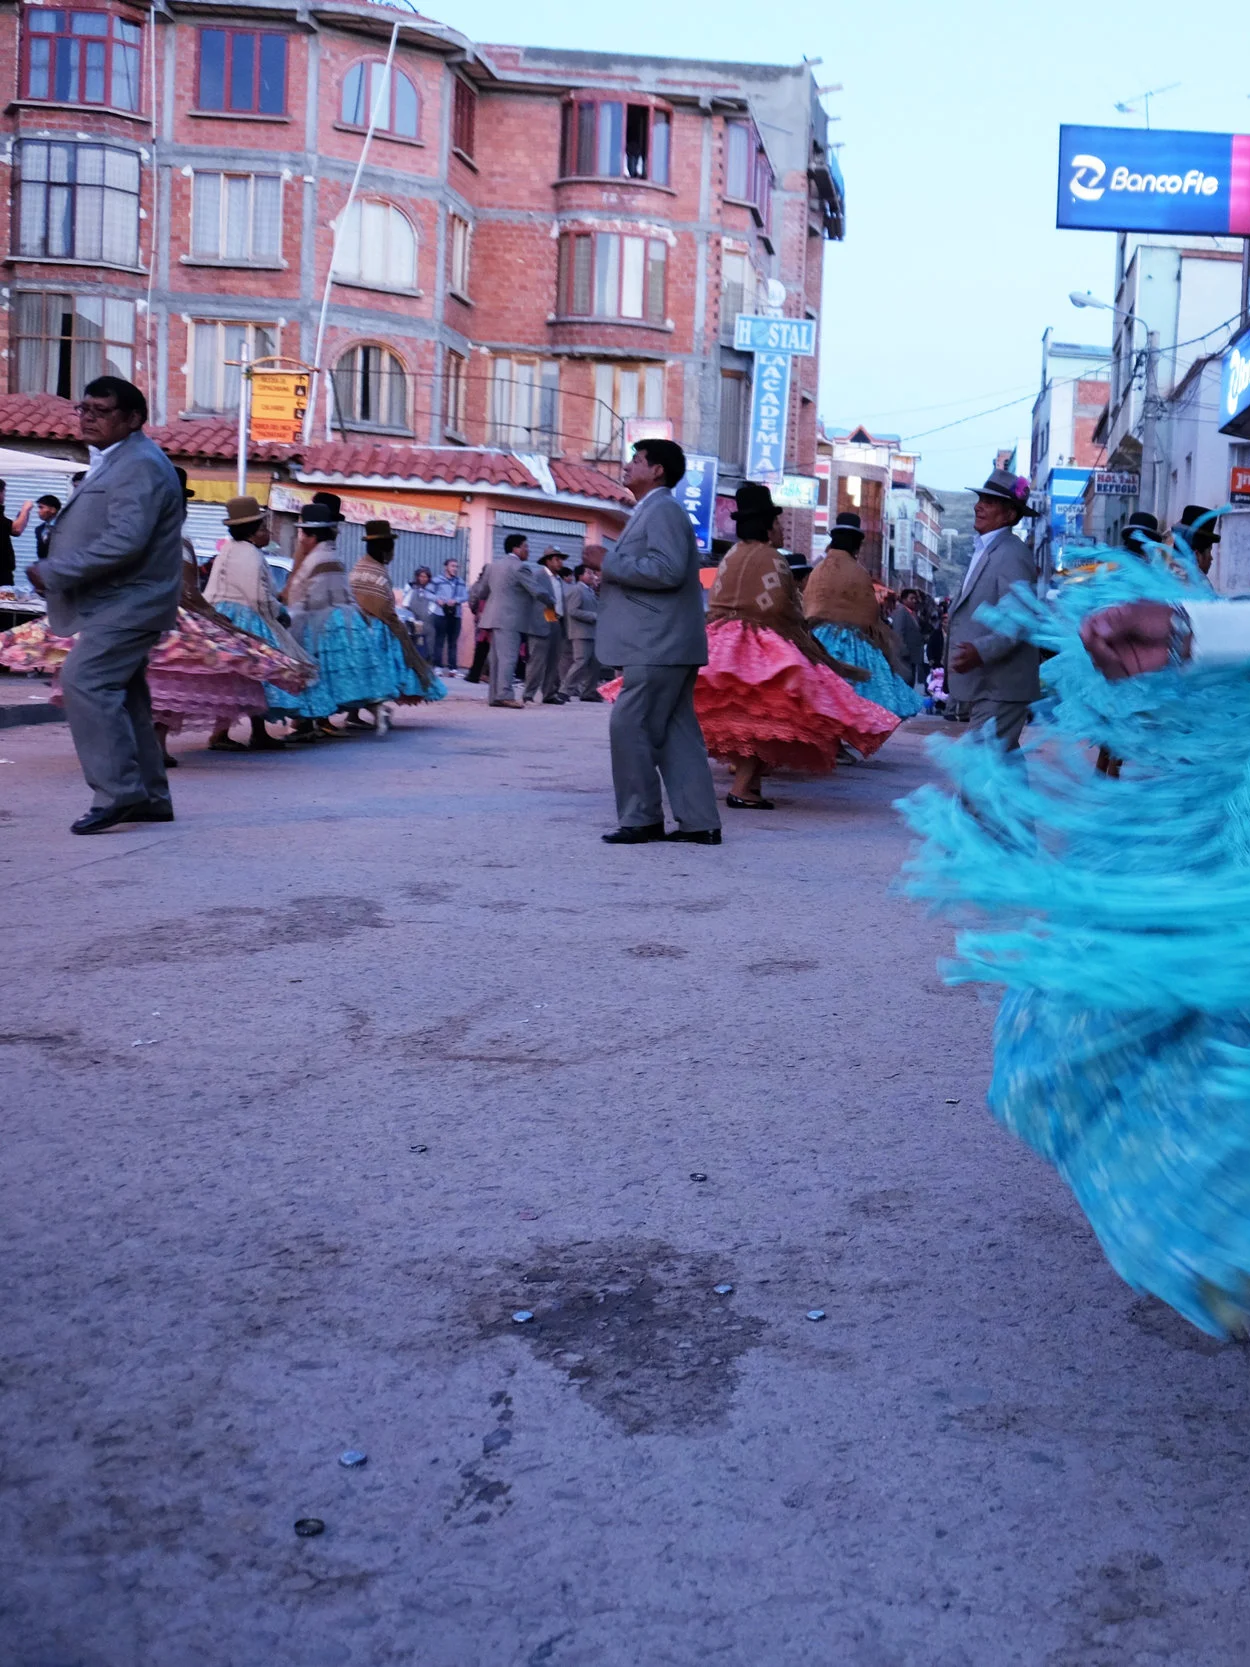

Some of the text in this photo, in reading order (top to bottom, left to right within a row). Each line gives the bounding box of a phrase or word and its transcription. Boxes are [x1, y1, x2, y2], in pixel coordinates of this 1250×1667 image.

[738, 320, 811, 350] HOSTAL
[758, 354, 786, 365] LA
[1097, 484, 1137, 493] REFUGIO
